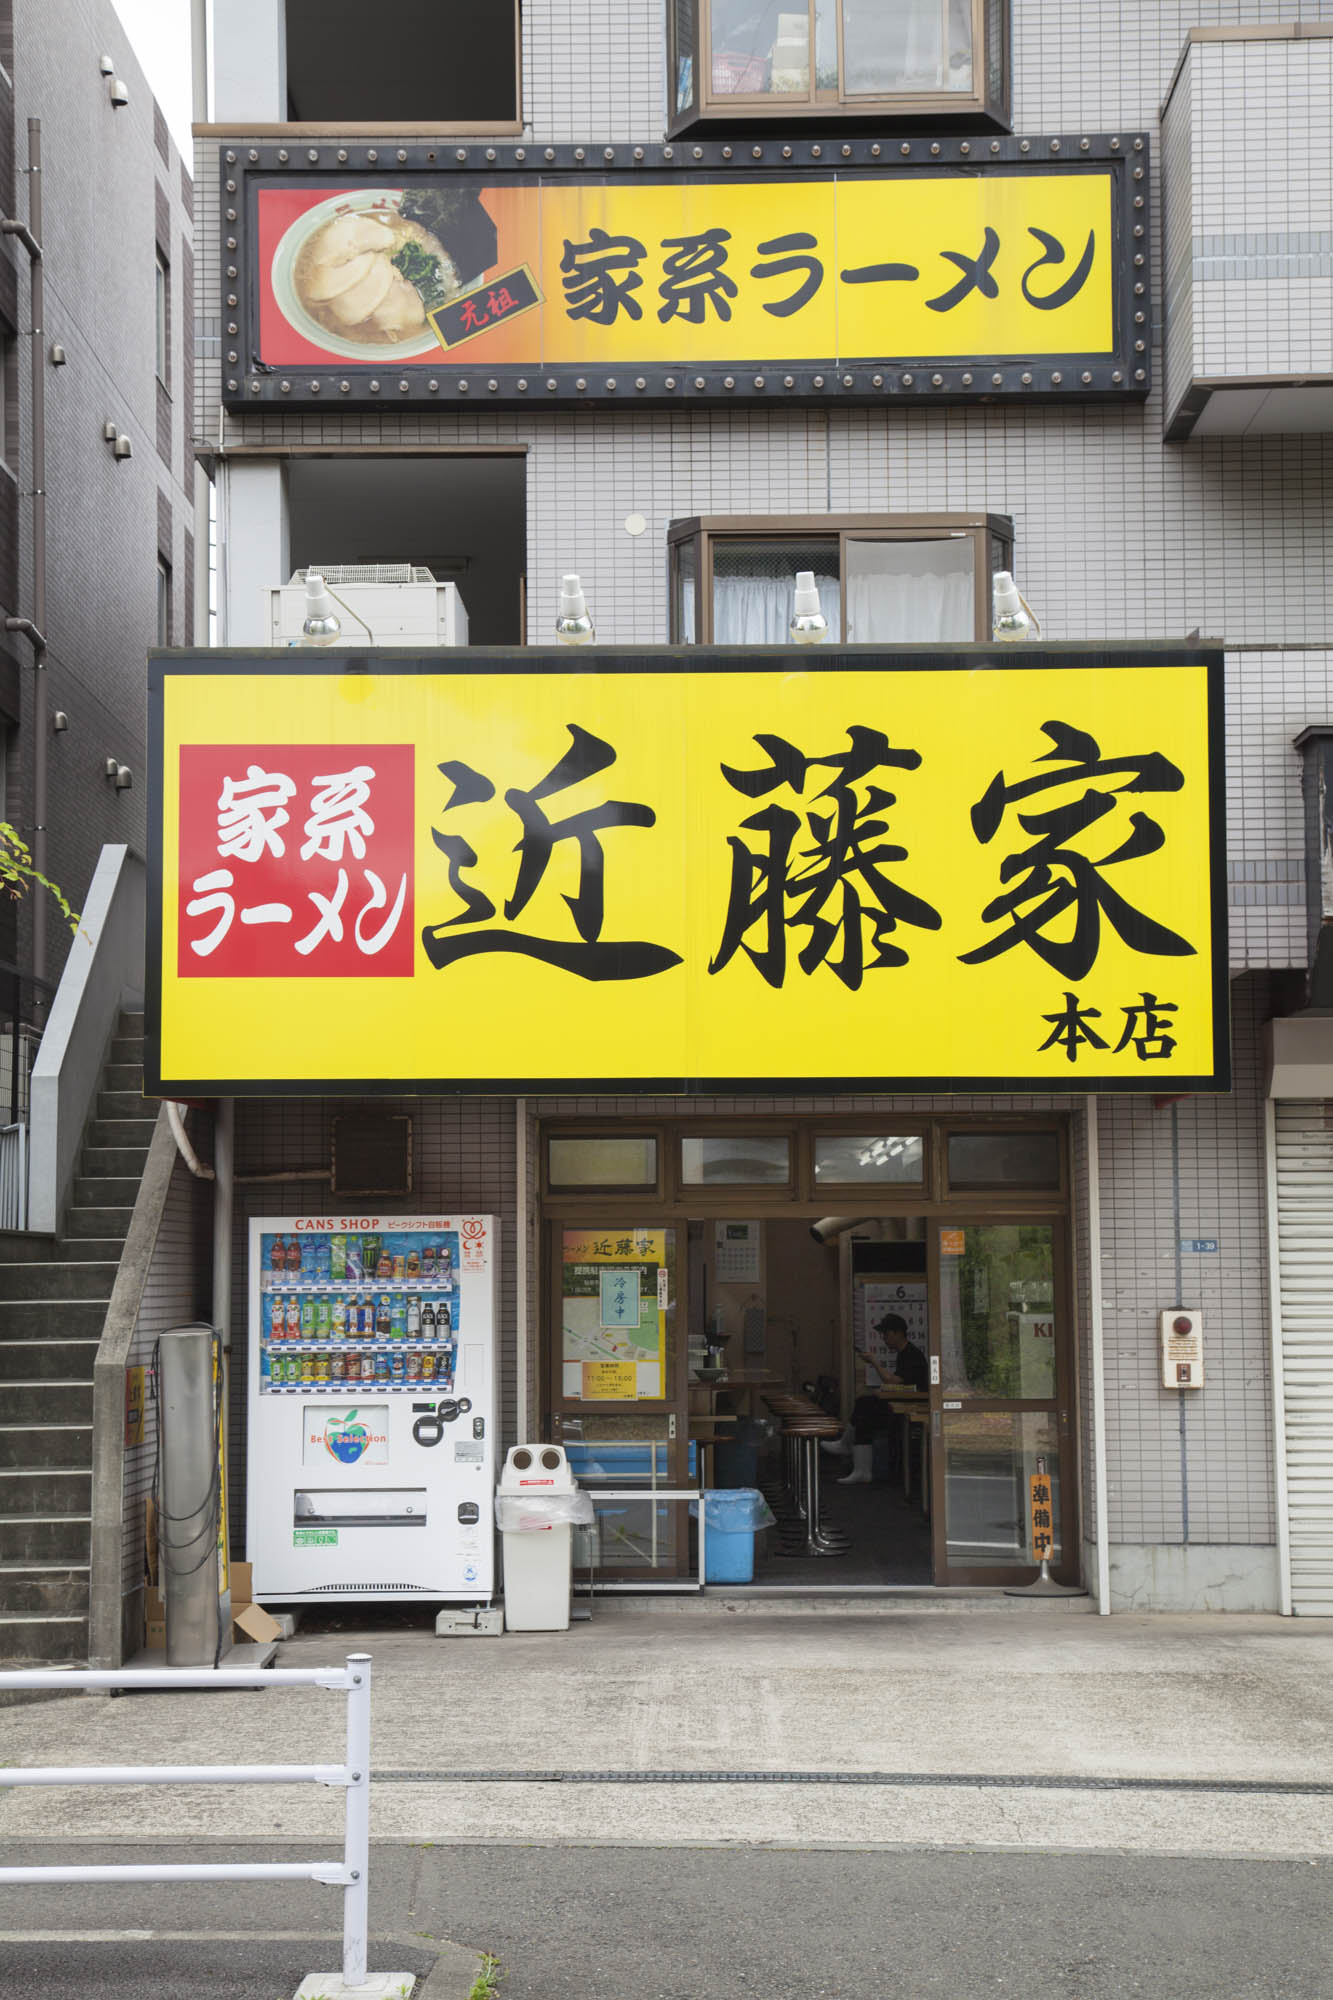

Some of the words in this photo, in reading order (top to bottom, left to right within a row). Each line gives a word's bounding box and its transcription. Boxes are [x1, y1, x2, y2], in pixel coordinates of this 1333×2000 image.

[459, 287, 519, 331] 元祖
[561, 226, 1095, 326] 家系ラーメン
[216, 765, 376, 864] 家系
[421, 720, 1198, 991] 近藤家
[185, 868, 407, 957] ラーメン
[1036, 991, 1179, 1063] 本店
[295, 1219, 334, 1230] CANS
[340, 1218, 379, 1230] SHOP
[593, 1238, 656, 1257] 近藤家
[310, 1434, 333, 1443] Best
[336, 1433, 386, 1443] Selection
[1032, 1484, 1051, 1553] 準備中
